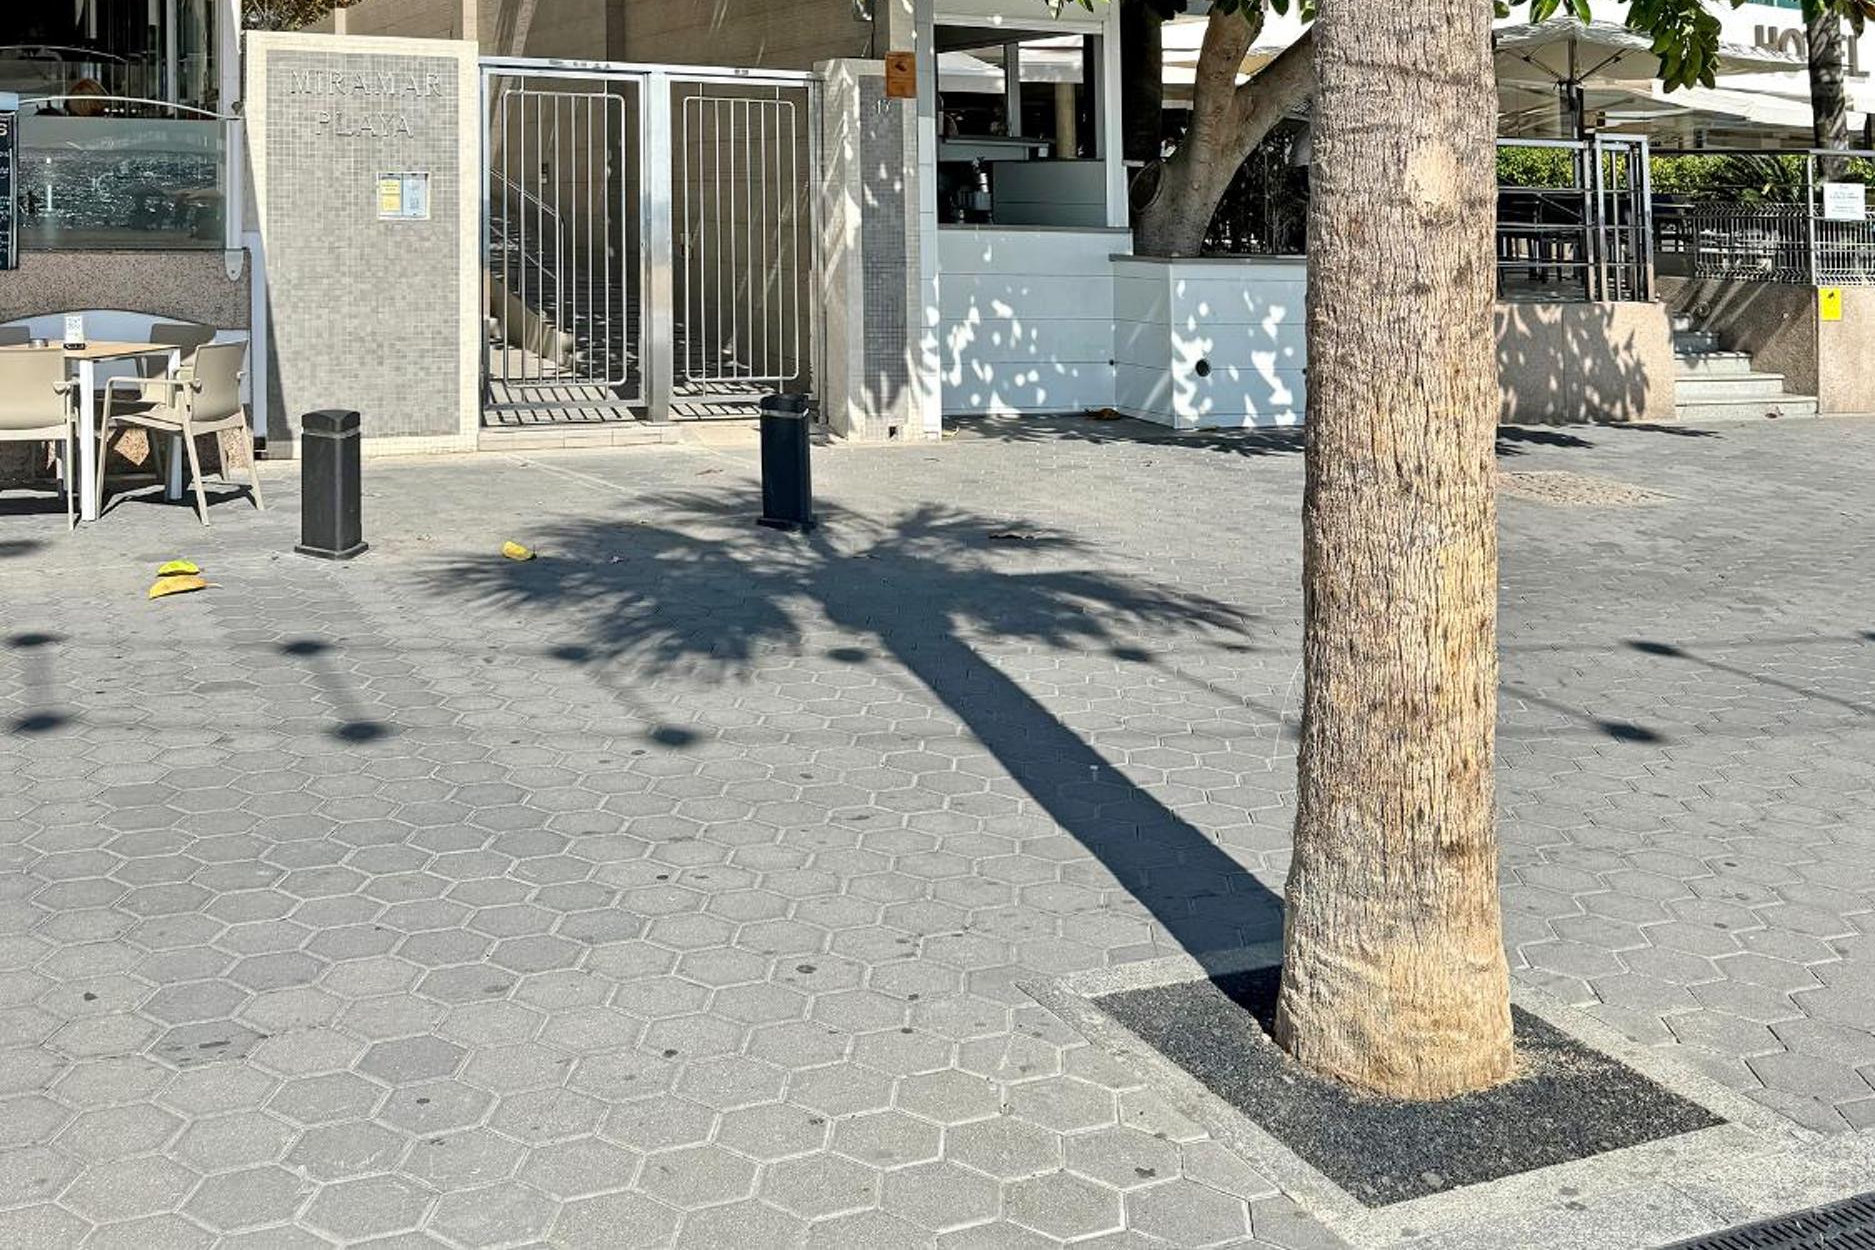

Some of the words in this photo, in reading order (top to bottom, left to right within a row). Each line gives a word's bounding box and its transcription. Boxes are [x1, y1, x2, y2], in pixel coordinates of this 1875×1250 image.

[1754, 24, 1870, 78] HOL
[290, 69, 443, 98] MIRAMAR
[314, 110, 414, 139] PLAYA
